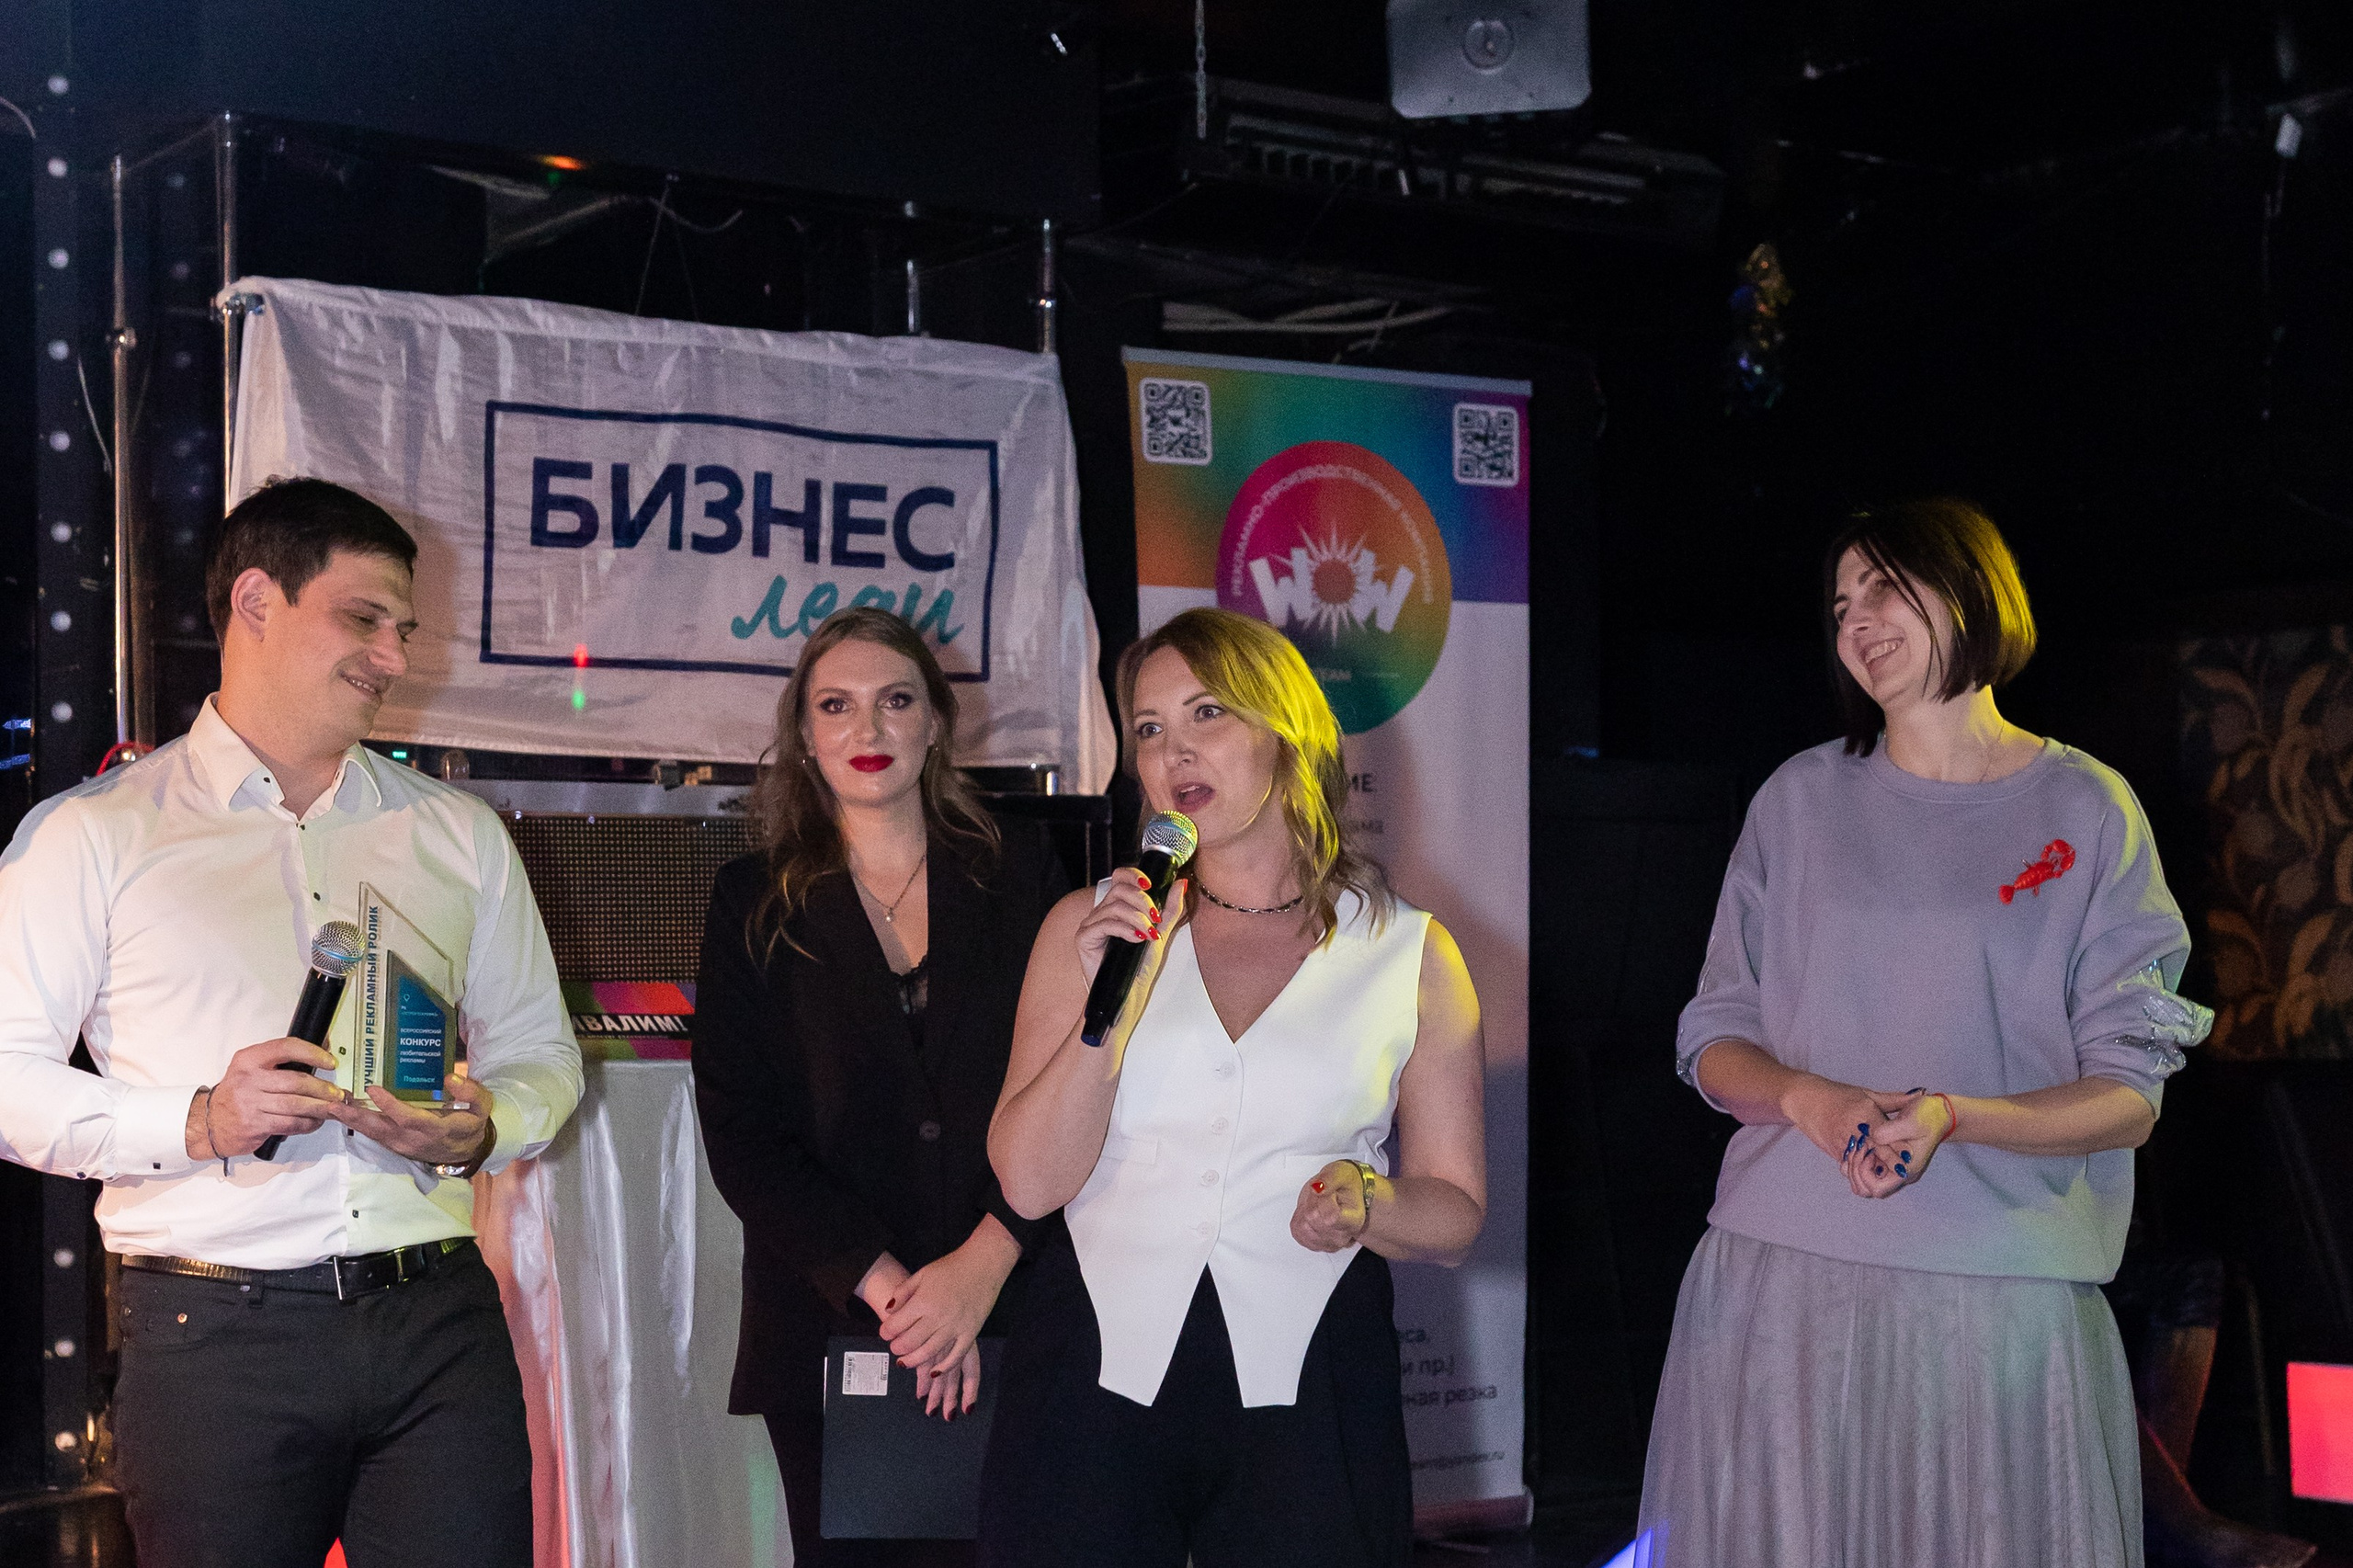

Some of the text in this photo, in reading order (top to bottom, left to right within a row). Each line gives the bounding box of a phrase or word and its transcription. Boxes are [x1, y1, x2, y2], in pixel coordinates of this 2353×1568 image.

[530, 456, 955, 572] БИЗНЕС
[368, 905, 379, 950] РОЛИК
[365, 952, 376, 1035] РЕКЛАМНЫЙ
[400, 1038, 441, 1047] КОНКУРС
